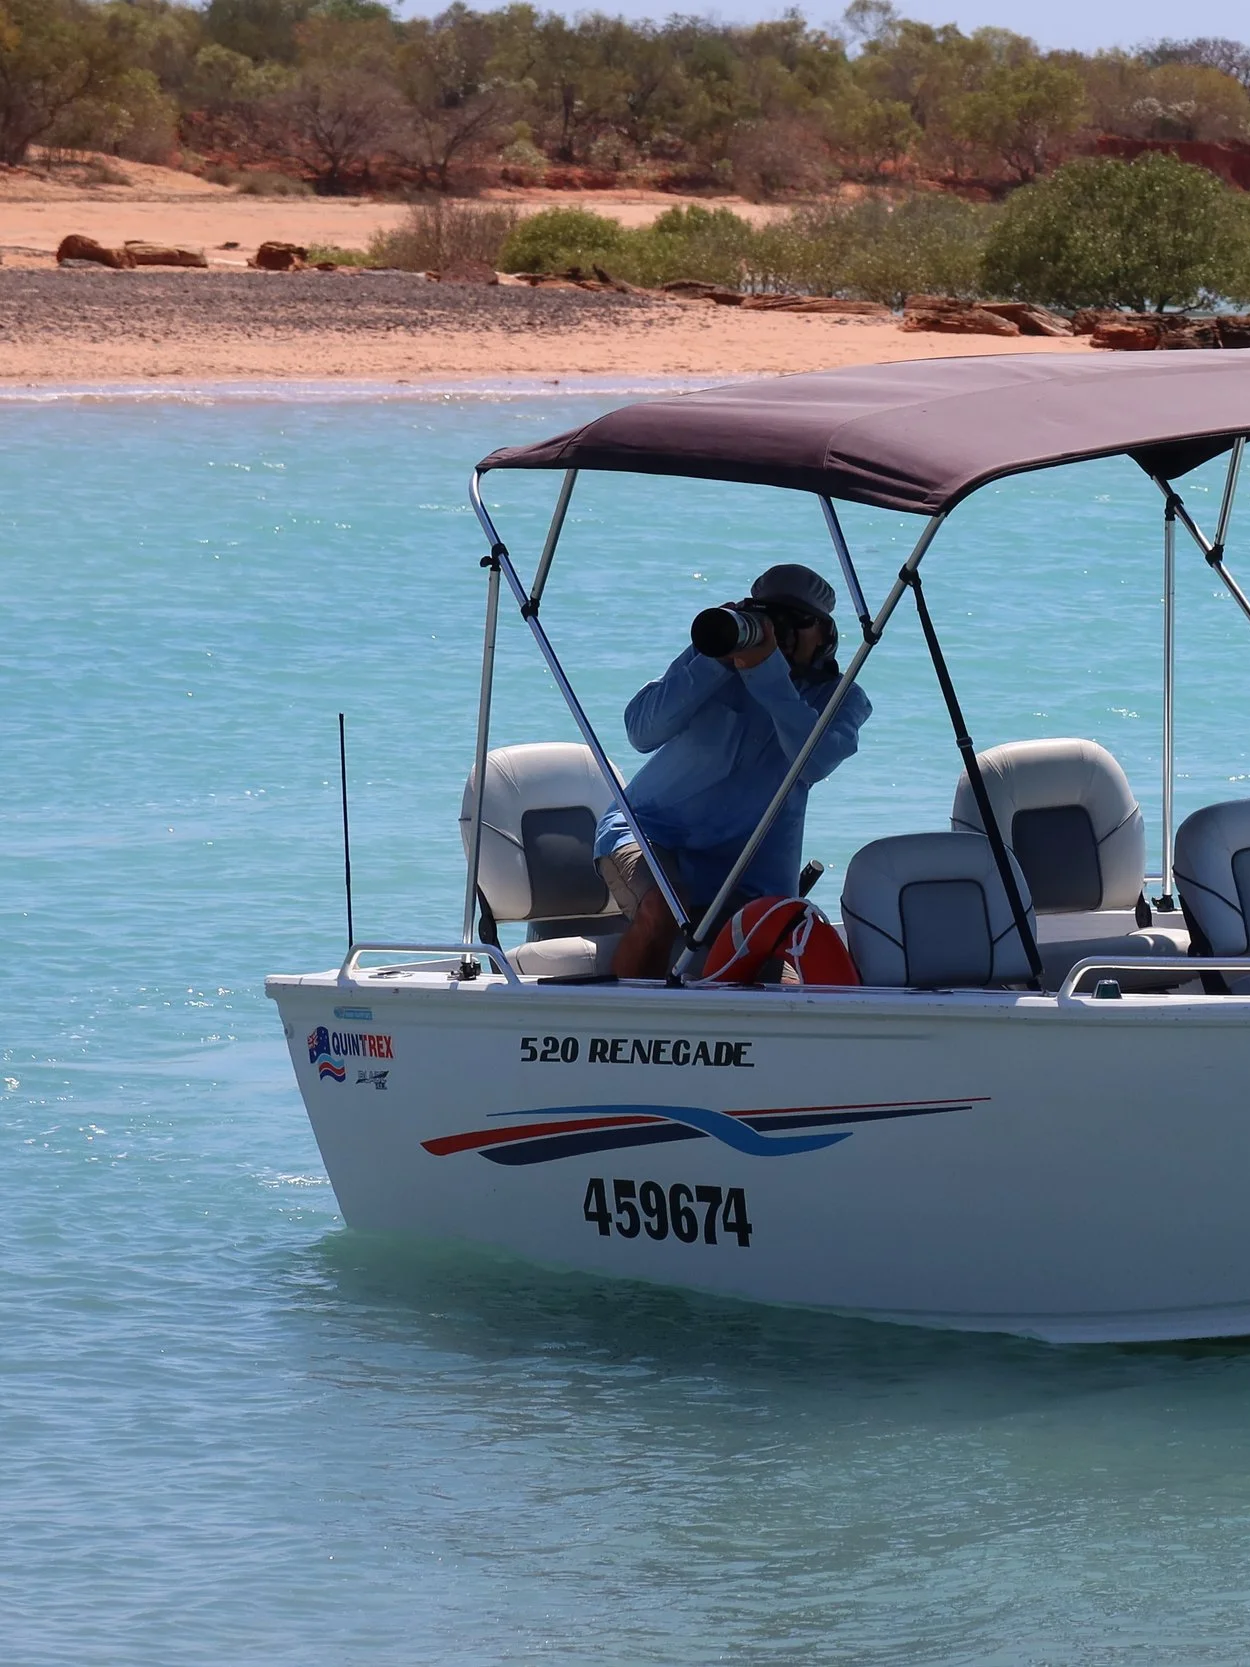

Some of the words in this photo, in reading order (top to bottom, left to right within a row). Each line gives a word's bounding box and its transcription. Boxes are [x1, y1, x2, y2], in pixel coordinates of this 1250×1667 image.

[331, 1031, 394, 1059] QUINTREX
[520, 1036, 580, 1063] 520
[588, 1037, 755, 1067] RENEGADE
[583, 1177, 753, 1248] 459674
